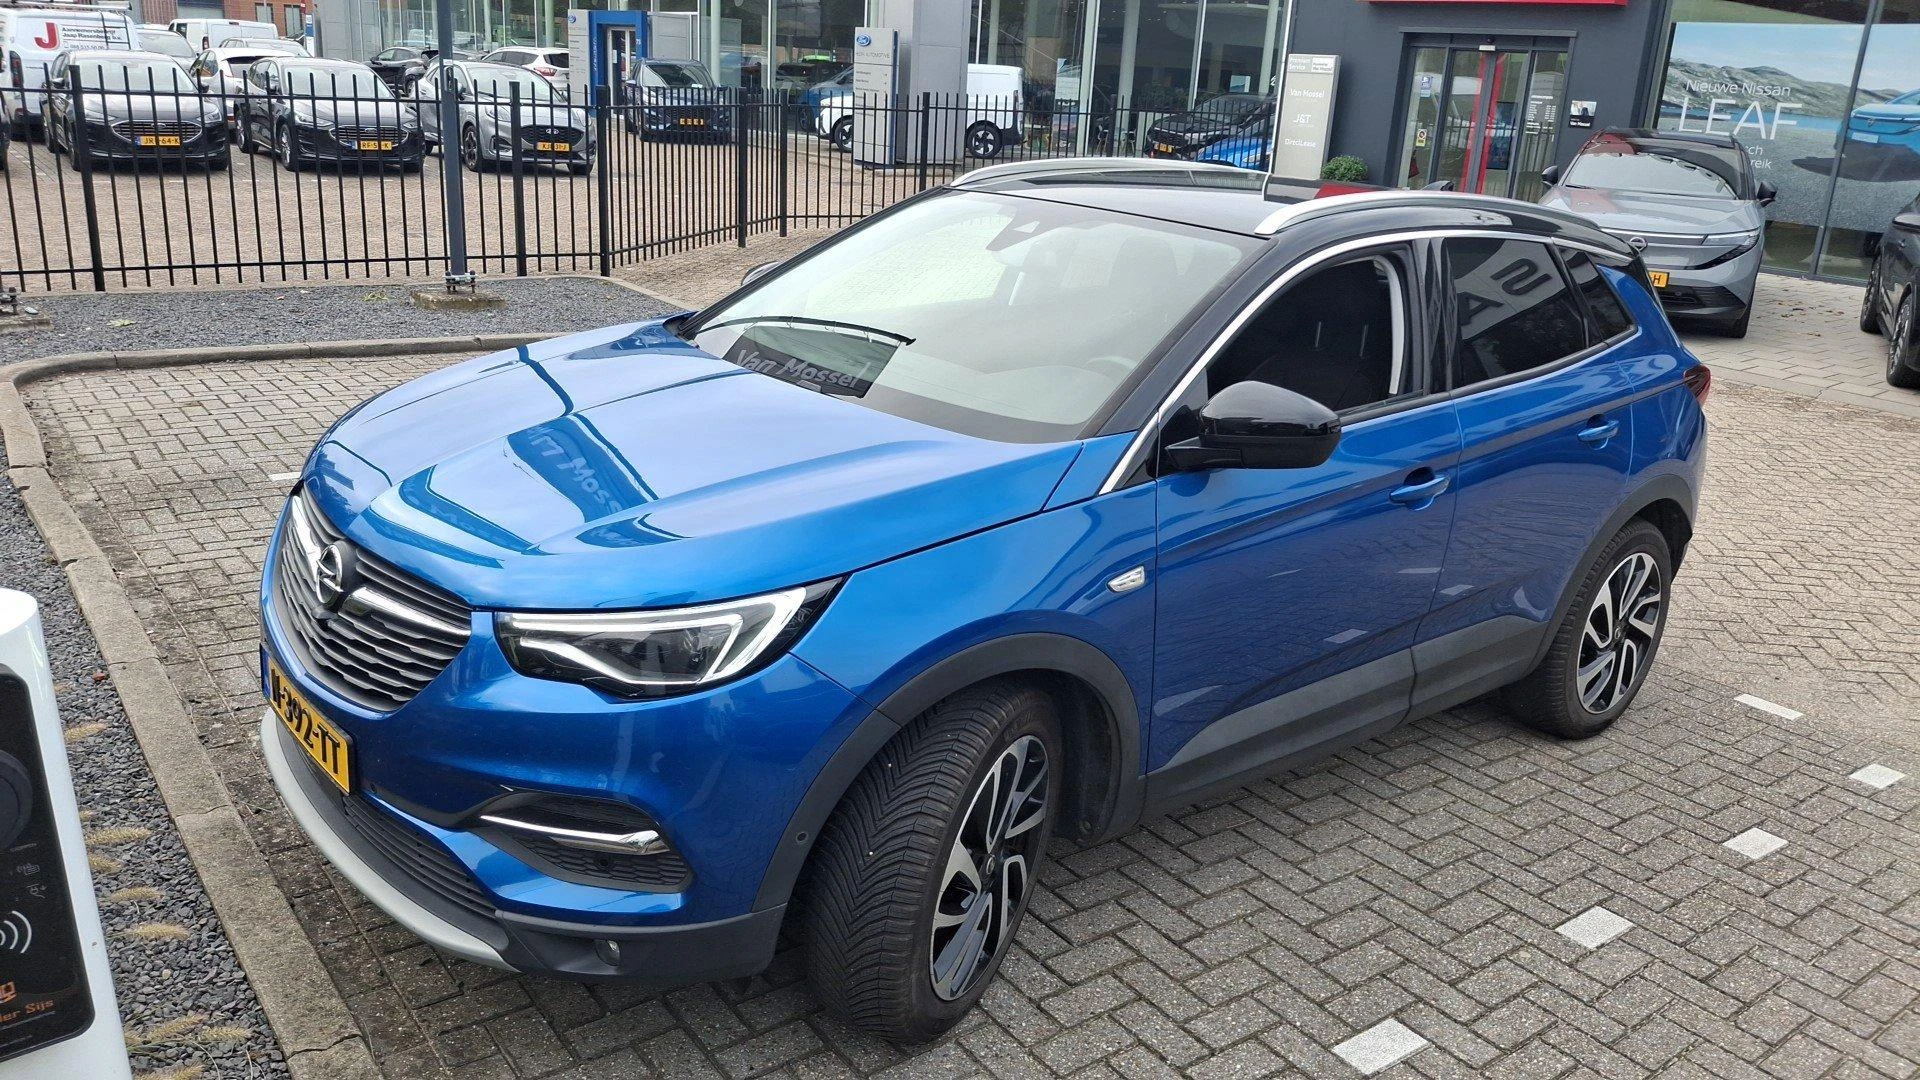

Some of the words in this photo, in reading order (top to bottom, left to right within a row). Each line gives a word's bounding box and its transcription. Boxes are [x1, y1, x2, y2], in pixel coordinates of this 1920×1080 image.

[34, 22, 57, 49] J
[1303, 89, 1325, 98] Mossel
[1686, 79, 1739, 94] Nieuwe
[1741, 82, 1791, 97] Nissan
[1678, 97, 1803, 140] LEAF
[736, 349, 778, 374] Van
[775, 357, 872, 388] Mossel
[25, 1000, 54, 1014] Sijs
